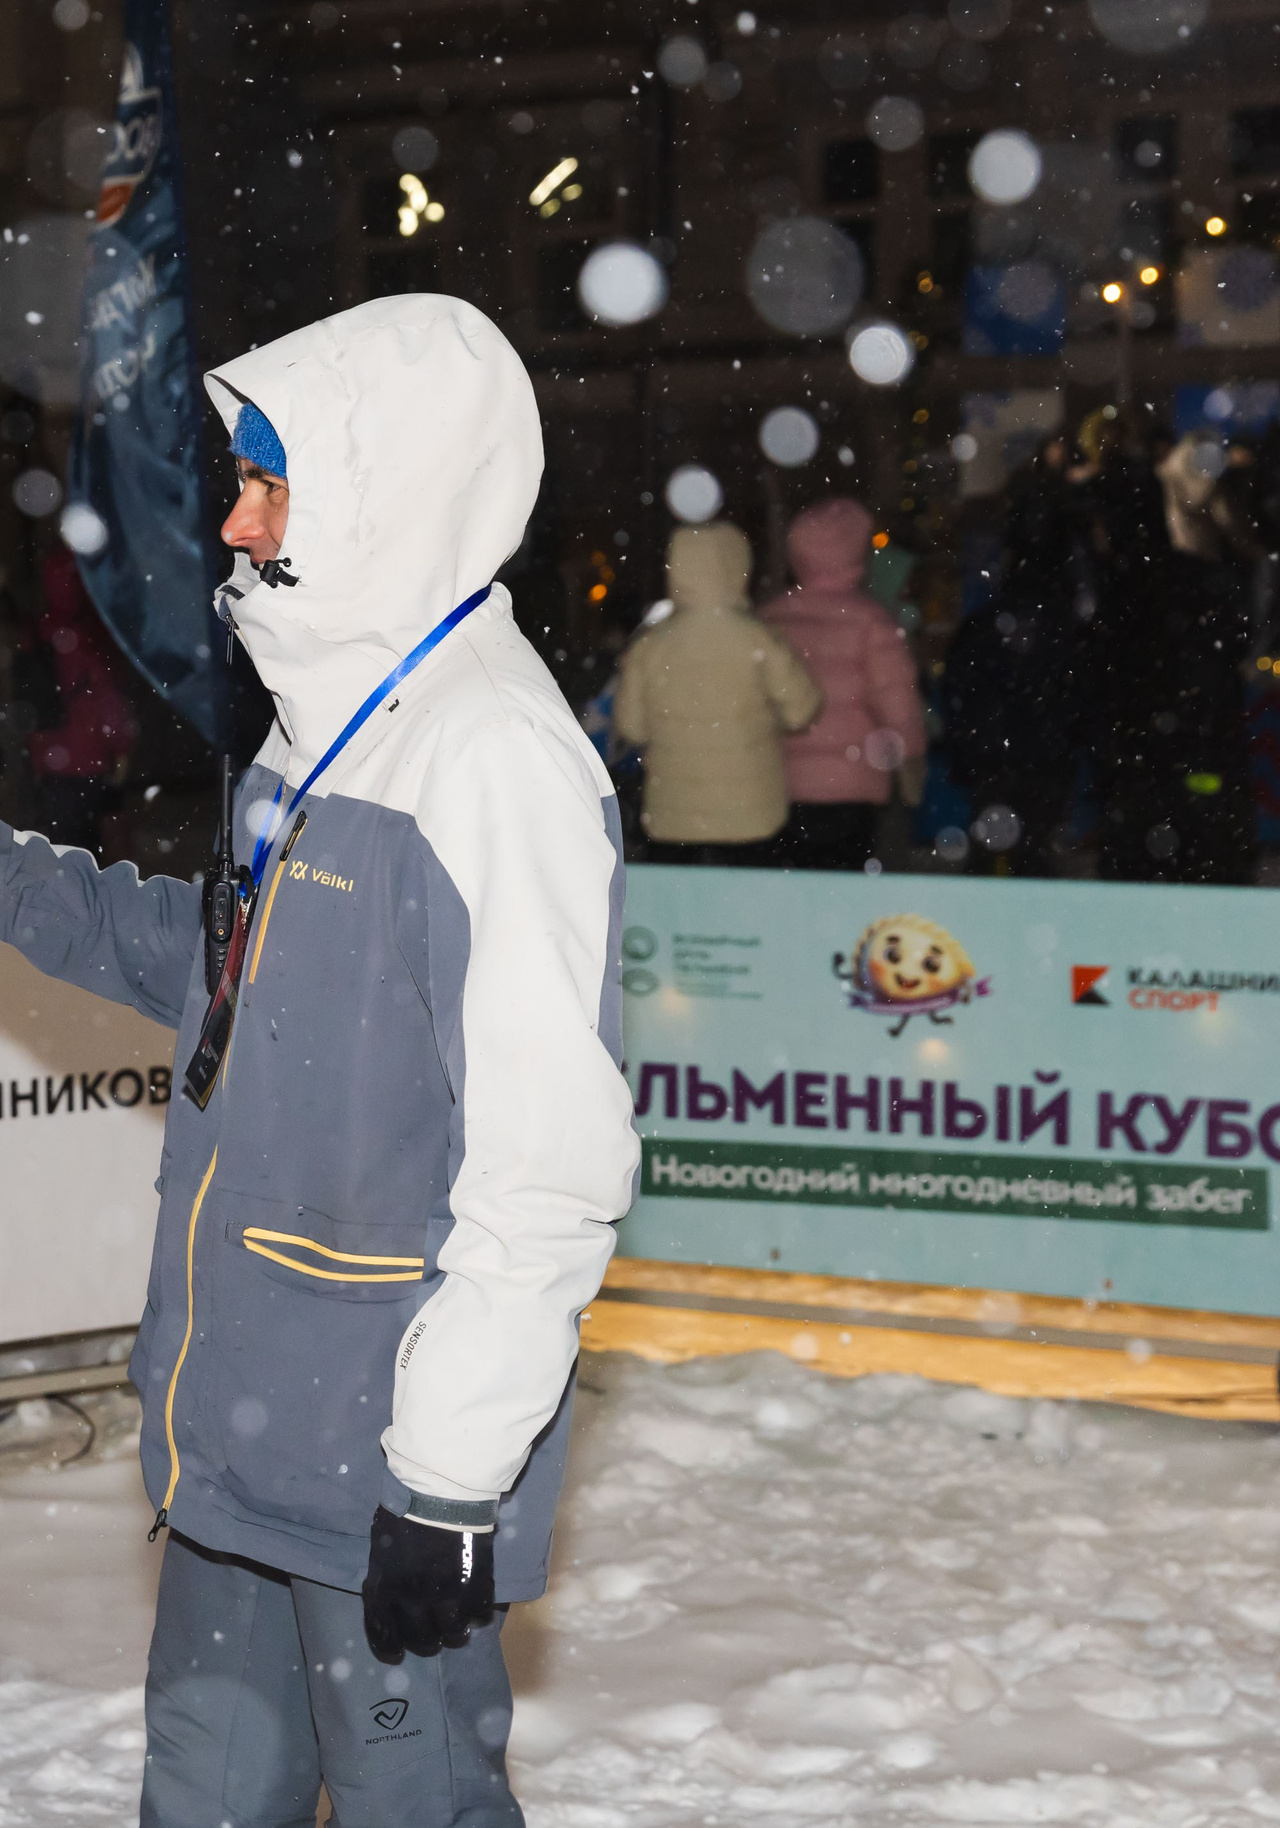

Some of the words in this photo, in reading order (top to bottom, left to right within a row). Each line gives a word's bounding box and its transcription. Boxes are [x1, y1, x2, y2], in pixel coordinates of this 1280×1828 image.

[1127, 988, 1221, 1012] СПОРТ
[623, 1062, 1070, 1146] ЛЬМЕННЫЙ
[651, 1153, 860, 1195] Новогодний
[869, 1171, 1138, 1208] многодневный
[1146, 1176, 1252, 1215] забег
[399, 1320, 427, 1371] SENSORTEX
[365, 1729, 423, 1746] NORTHLAND
